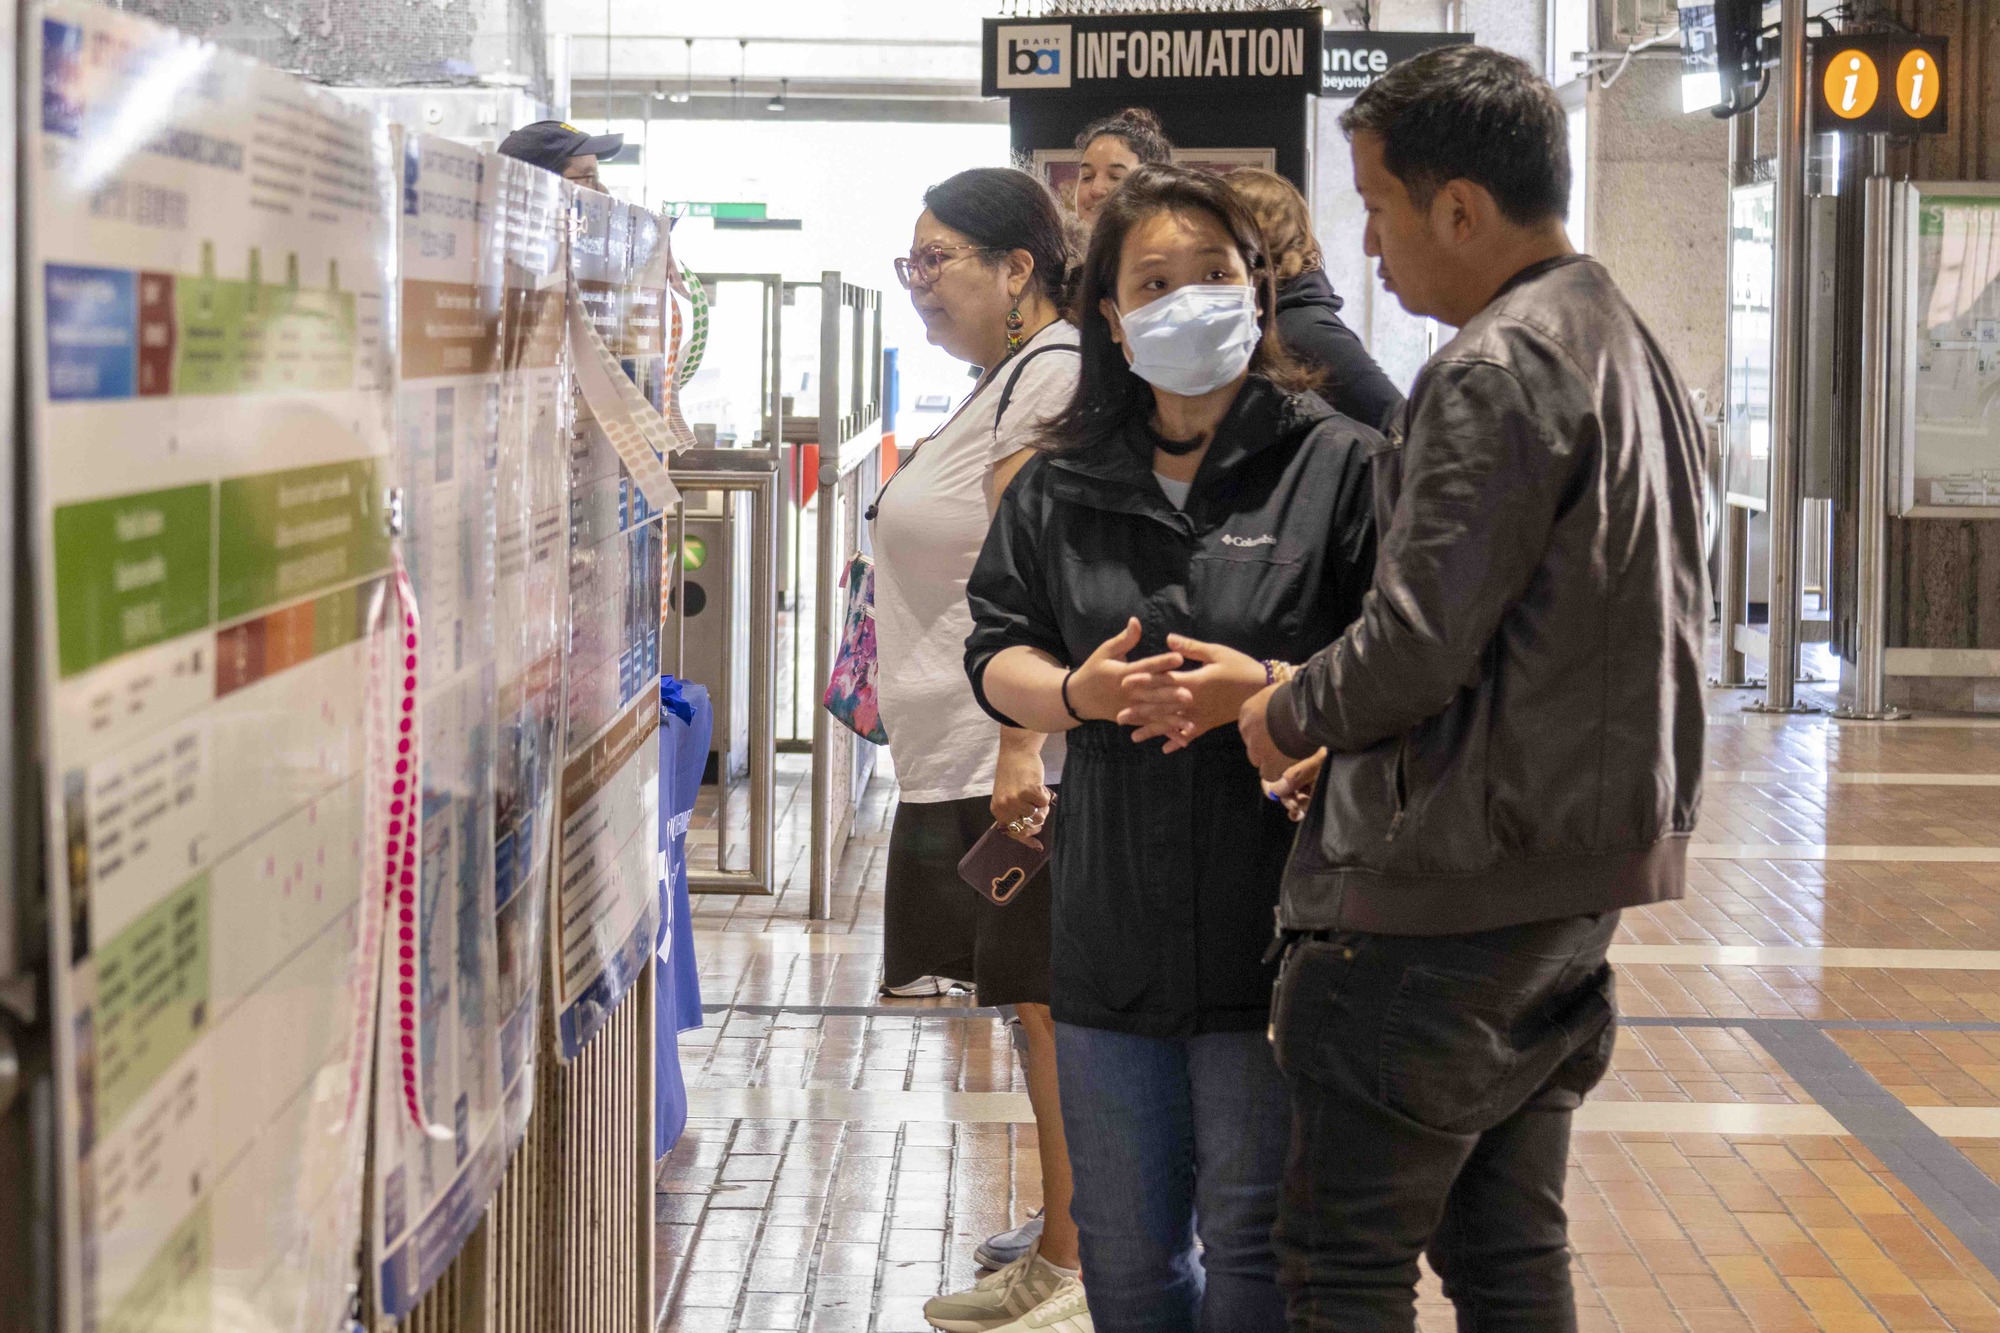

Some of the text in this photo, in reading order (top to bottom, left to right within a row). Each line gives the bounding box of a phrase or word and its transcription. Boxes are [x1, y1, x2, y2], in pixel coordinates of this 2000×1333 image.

[1022, 37, 1061, 46] BART
[1077, 28, 1304, 78] INFORMATION
[1323, 73, 1371, 91] beyond
